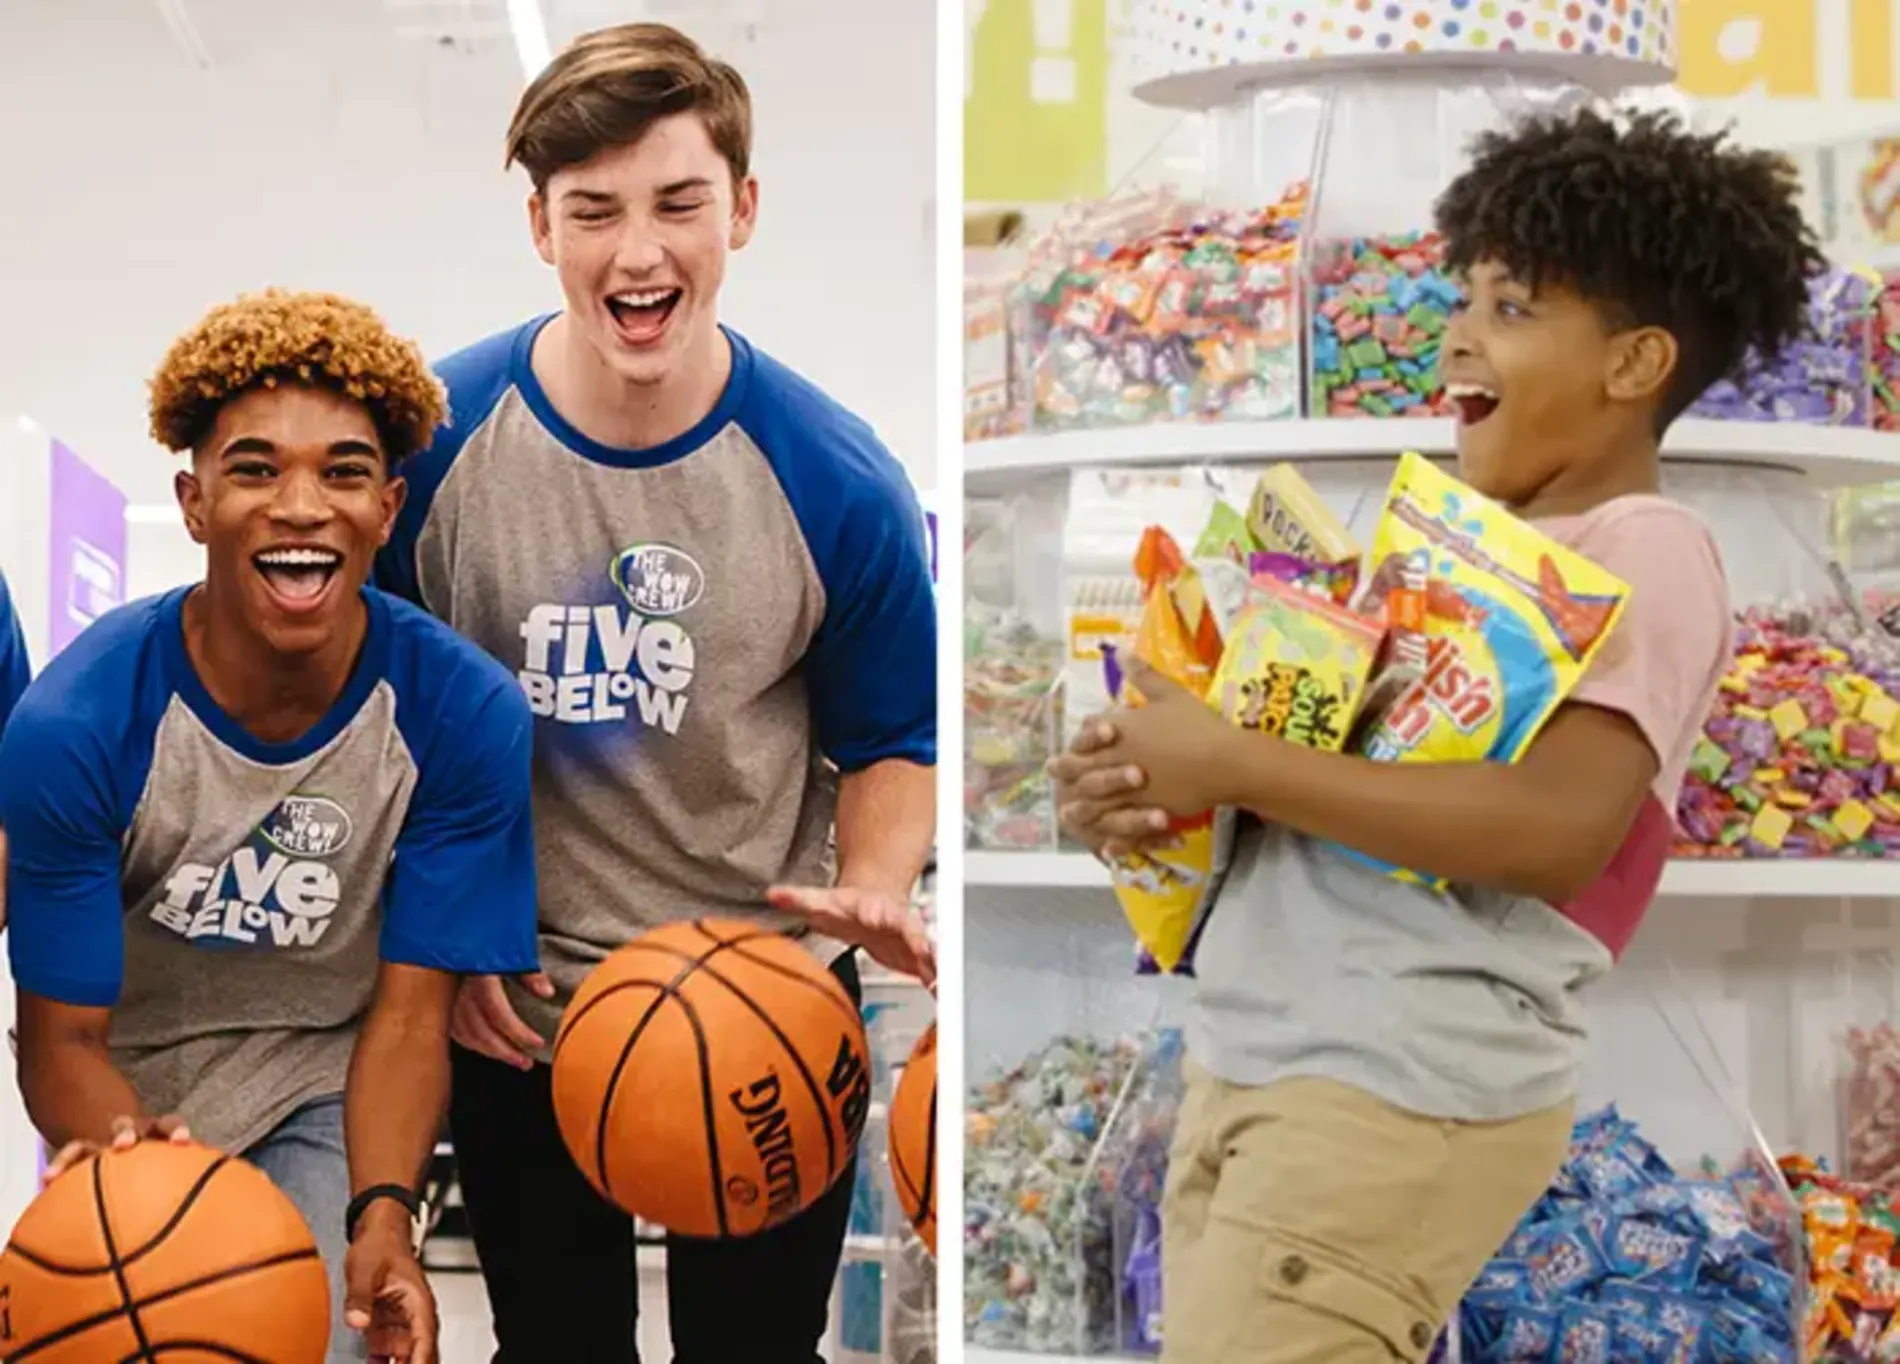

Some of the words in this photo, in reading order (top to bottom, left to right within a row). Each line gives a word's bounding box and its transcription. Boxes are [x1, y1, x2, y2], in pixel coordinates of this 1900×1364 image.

[1262, 492, 1316, 563] POCK
[632, 551, 667, 571] THE
[644, 571, 691, 594] WOW
[1260, 664, 1298, 736] PATC
[1284, 676, 1324, 746] SOU
[281, 800, 316, 821] THE
[272, 825, 332, 854] CREW!
[292, 818, 339, 840] WOW
[825, 1032, 871, 1148] BA
